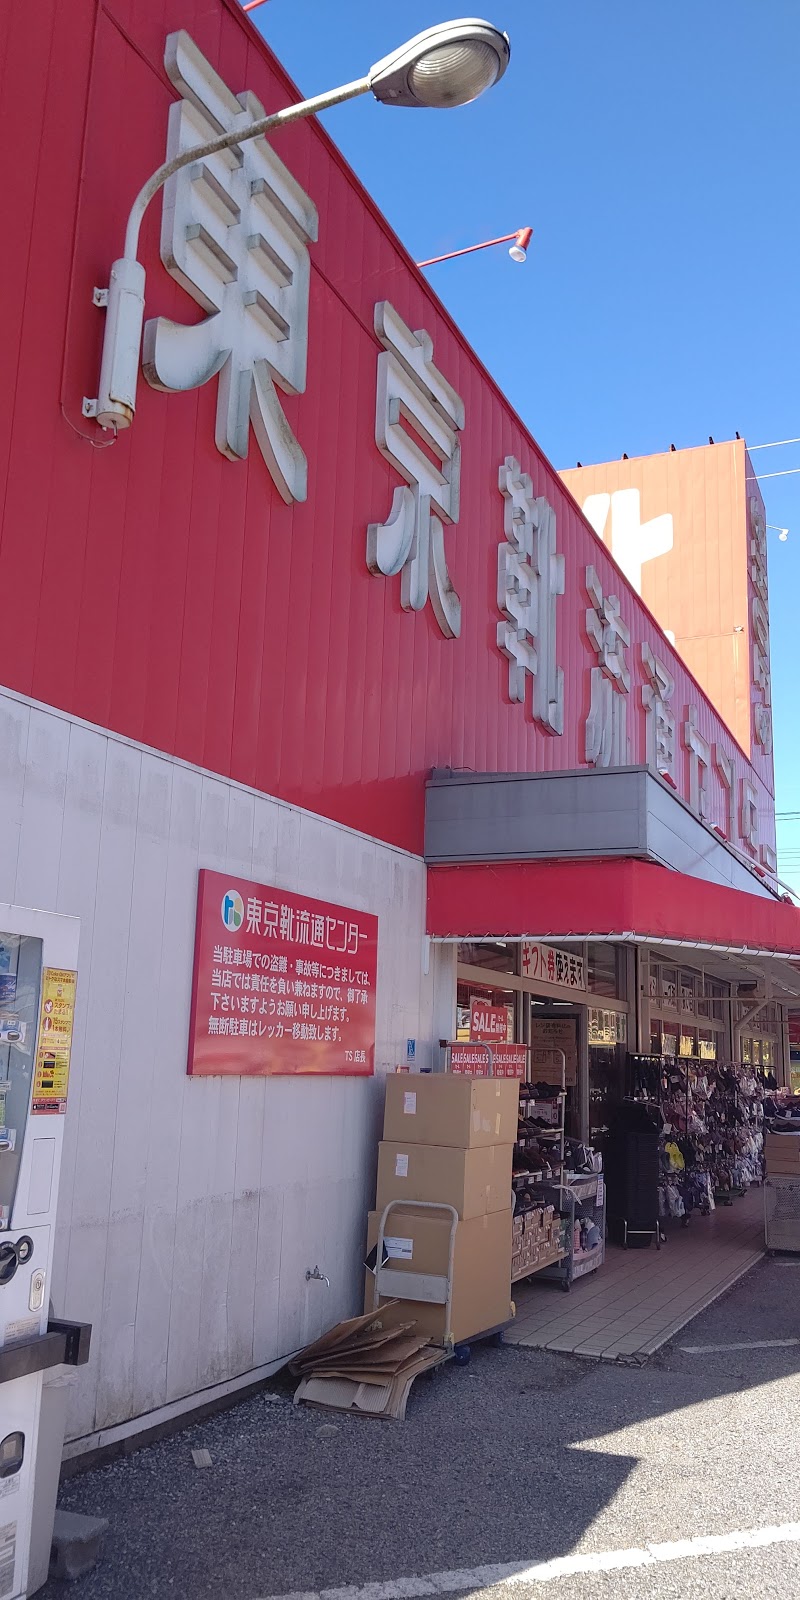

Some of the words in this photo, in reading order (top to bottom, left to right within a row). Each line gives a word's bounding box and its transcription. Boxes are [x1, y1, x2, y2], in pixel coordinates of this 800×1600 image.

[246, 896, 367, 955] 東京靴流通センター
[213, 945, 371, 986] 当駐車場での盗難・事故等につきましては、
[523, 942, 583, 985] ギフト券使えます
[211, 968, 368, 1005] 当店では責任を負い兼ねますので、御了承
[210, 992, 350, 1023] 下さいますようお願い申し上げます。
[472, 1011, 496, 1033] SALE
[208, 1015, 342, 1042] 無断駐車はレッカー移動致します。
[345, 1050, 353, 1062] TS
[353, 1050, 366, 1063] 店長
[451, 1053, 463, 1063] SALE
[463, 1053, 475, 1063] SALE
[475, 1054, 486, 1063] SALE
[496, 1054, 506, 1064] SALE
[506, 1054, 517, 1064] SALE
